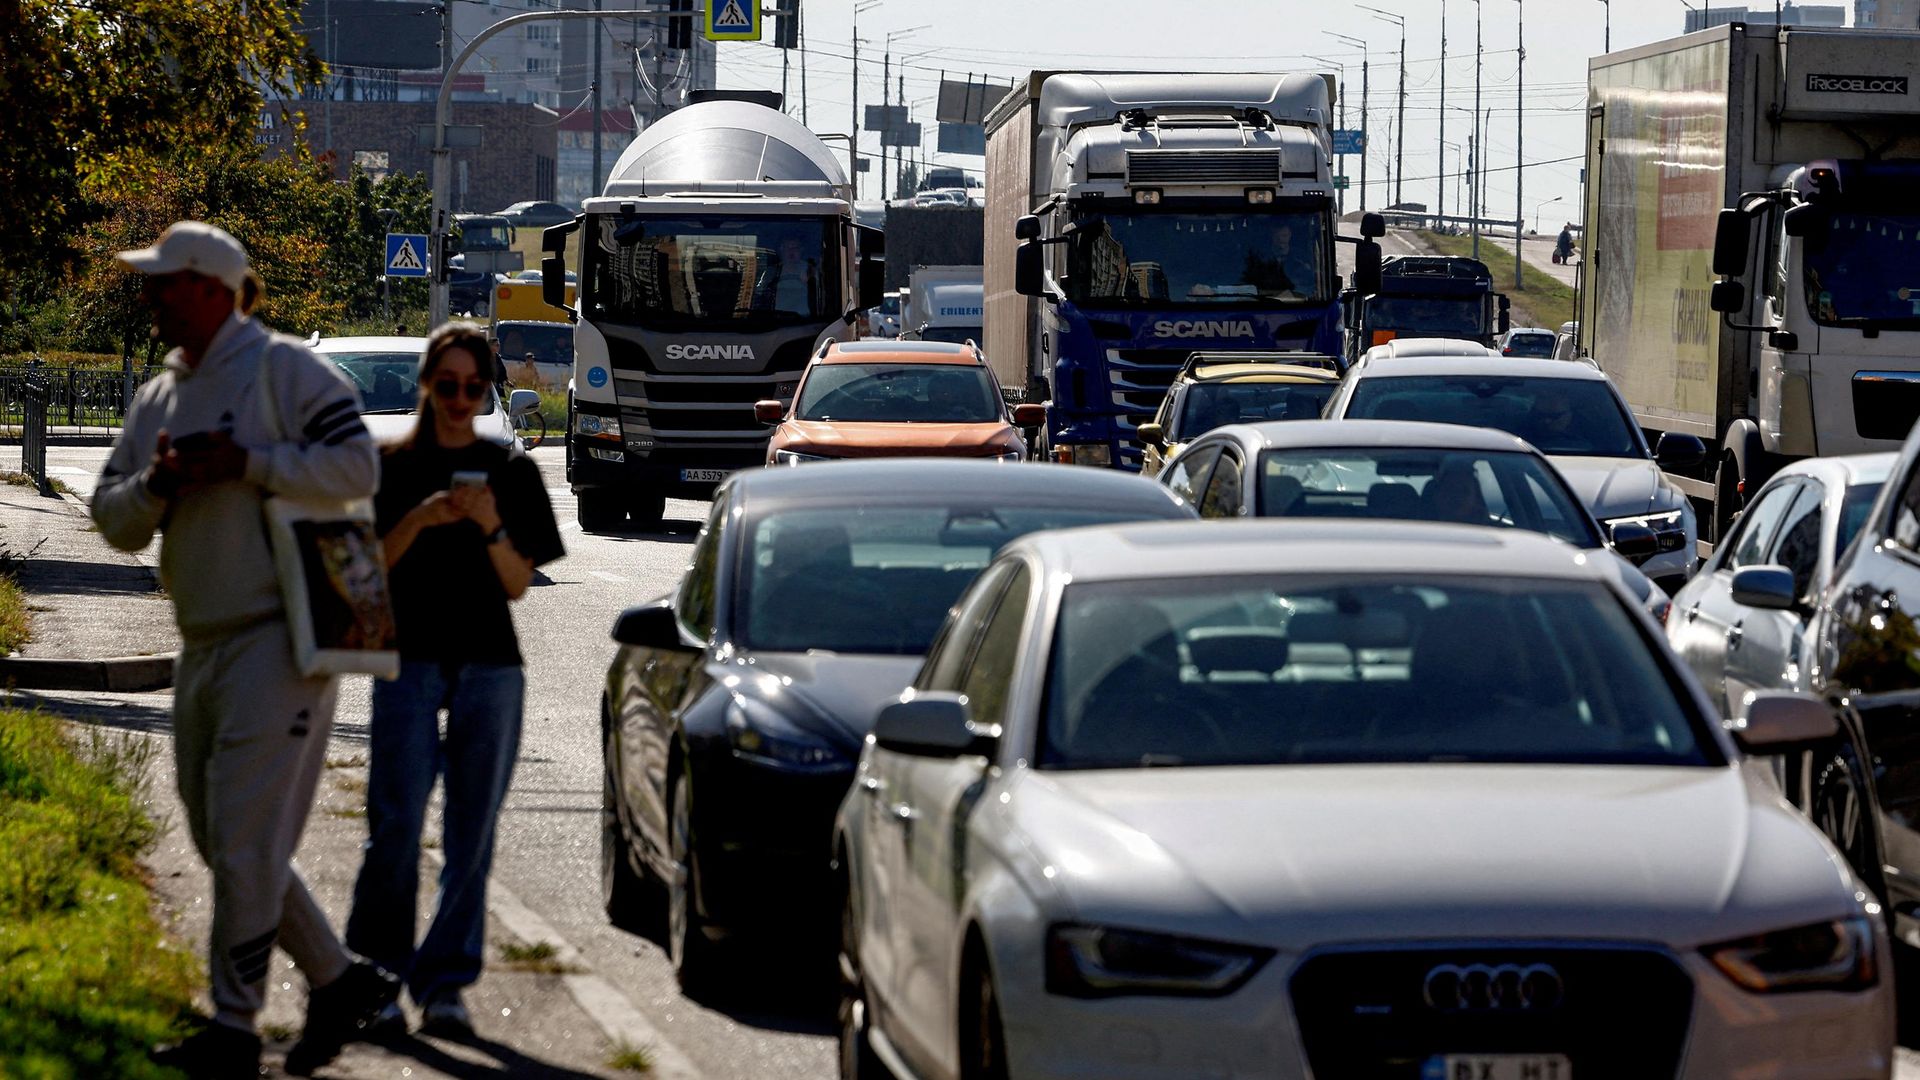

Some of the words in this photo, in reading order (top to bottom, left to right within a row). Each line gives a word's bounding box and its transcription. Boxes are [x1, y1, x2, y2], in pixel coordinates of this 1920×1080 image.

[256, 134, 280, 145] RKET
[941, 307, 983, 316] ЕПІЦЕНТ
[1154, 320, 1256, 338] SCANIA
[665, 344, 756, 361] SCANIA
[686, 470, 700, 481] AA
[701, 470, 723, 481] 3579
